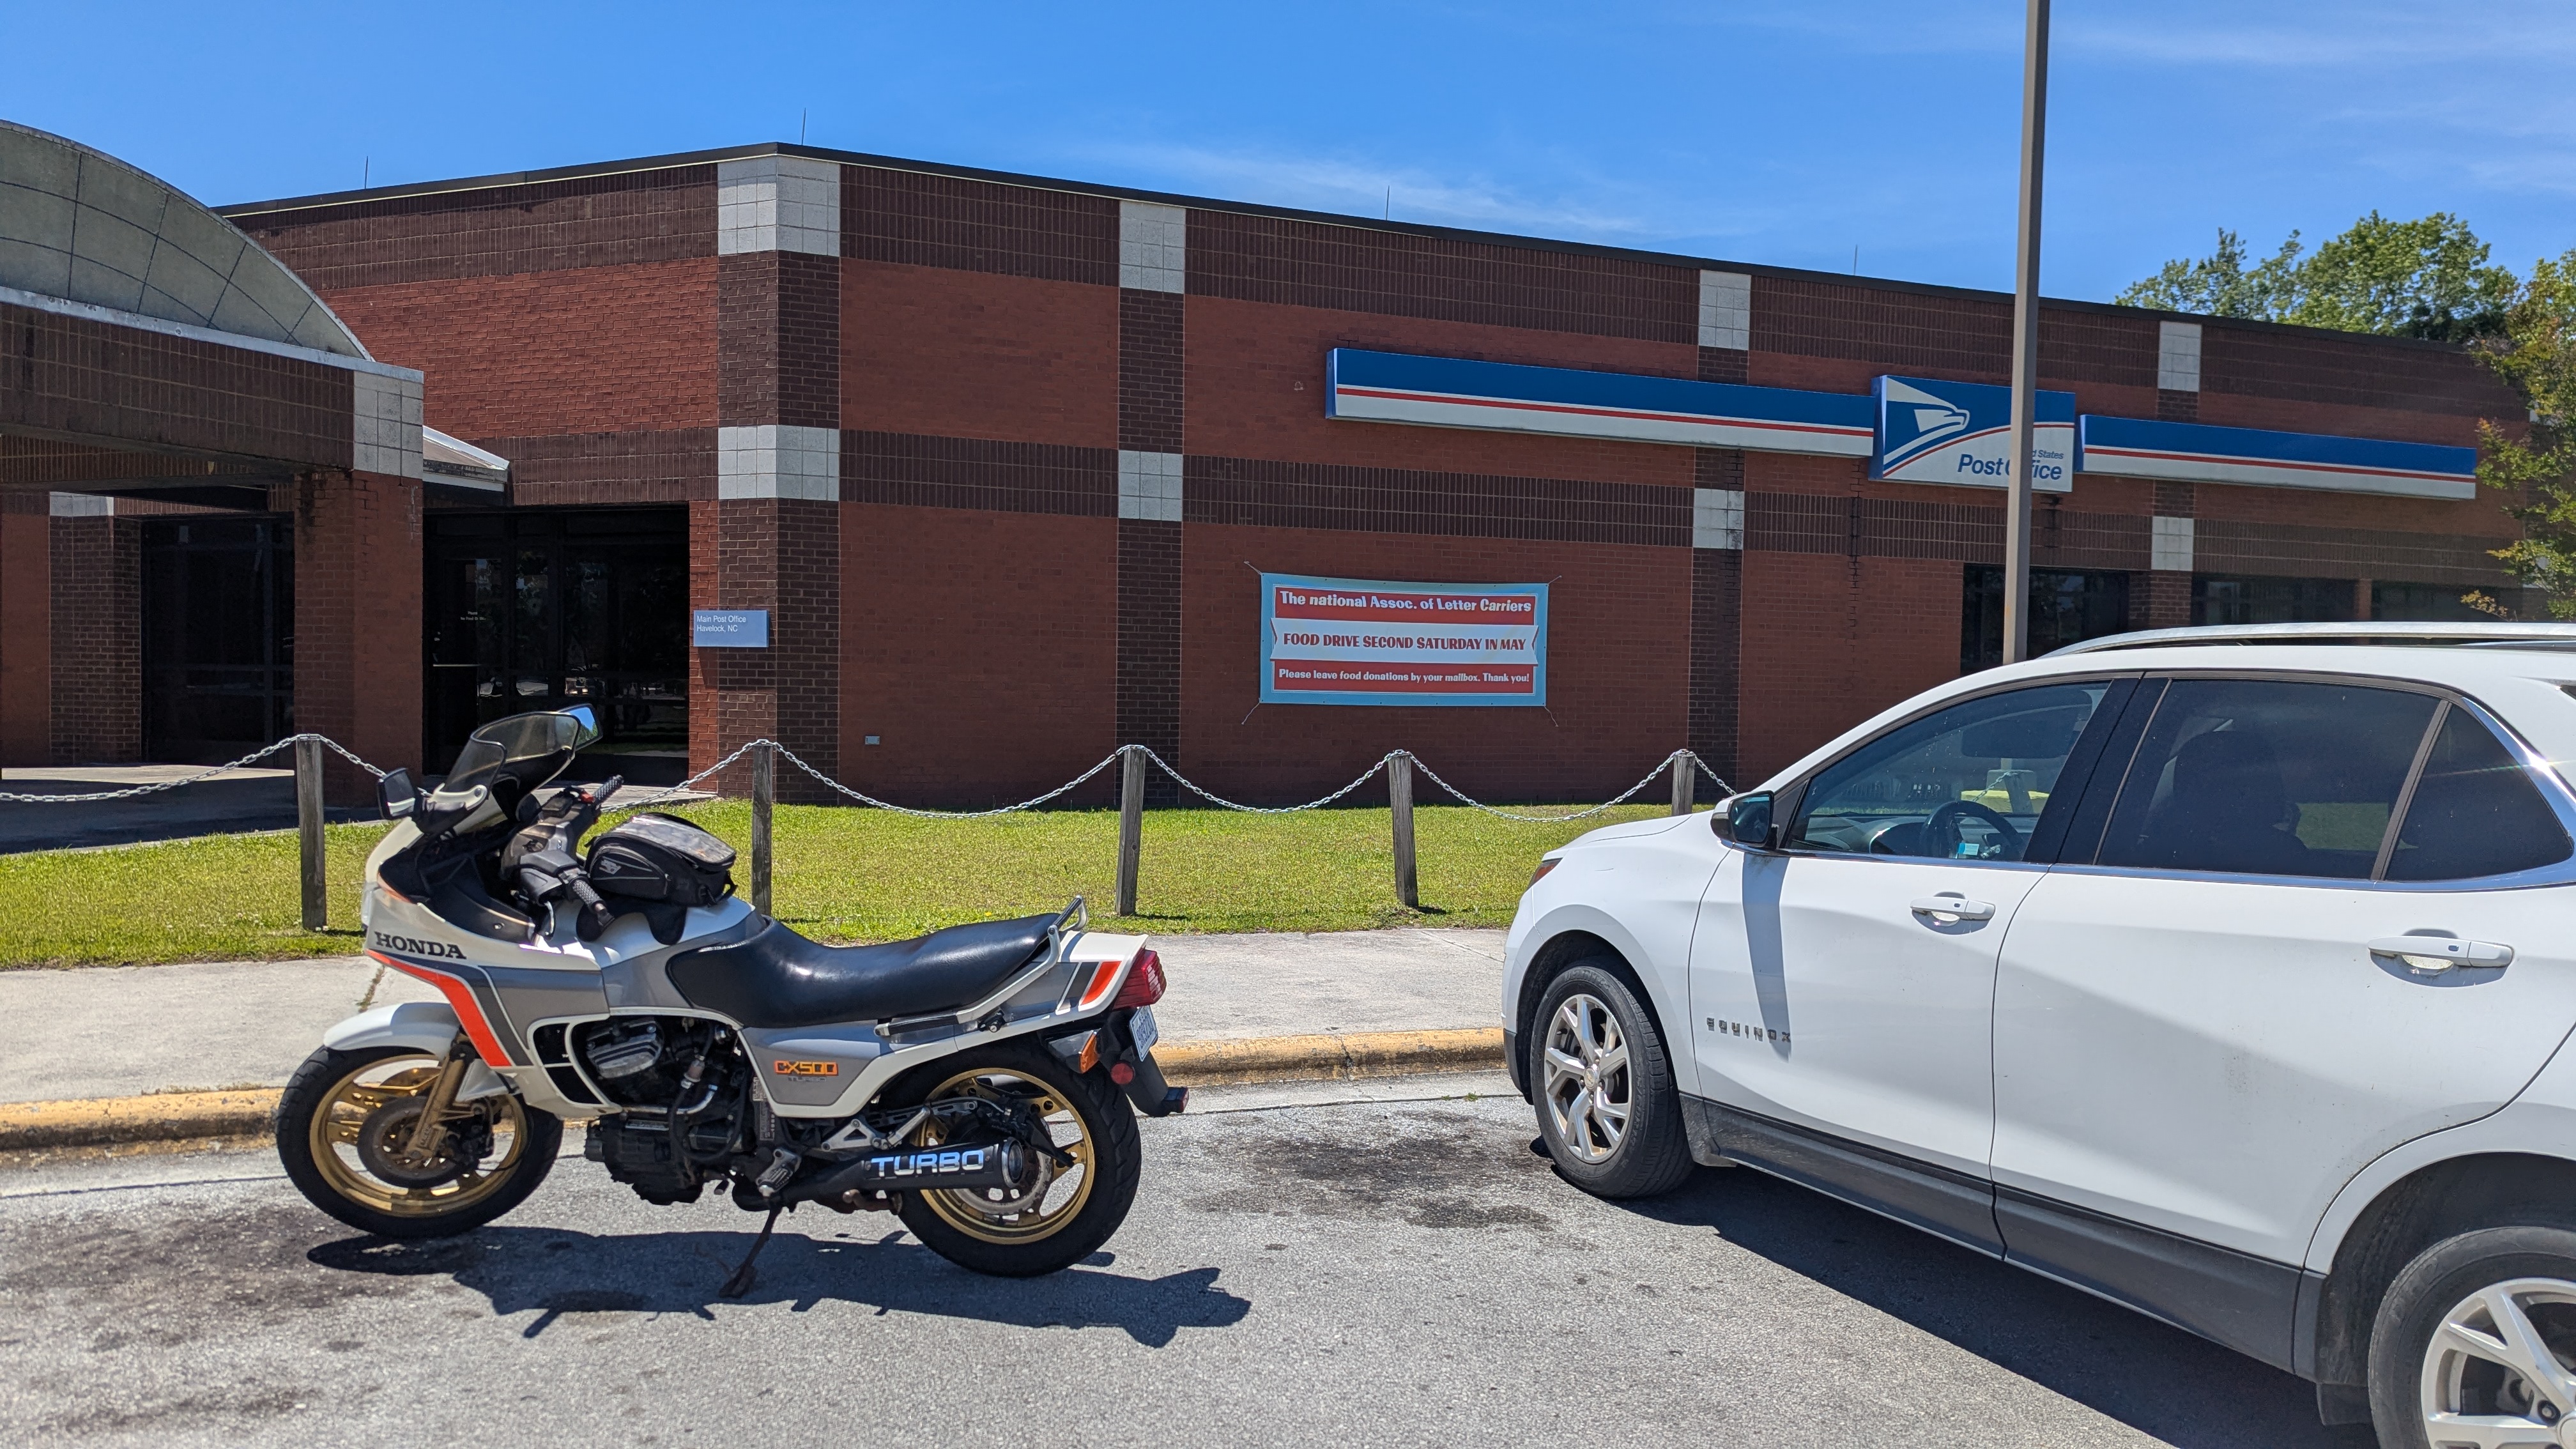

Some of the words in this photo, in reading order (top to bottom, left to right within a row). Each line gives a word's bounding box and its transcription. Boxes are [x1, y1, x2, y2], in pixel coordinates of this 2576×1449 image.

[1958, 454, 2004, 476] Post
[2038, 450, 2064, 459] States
[1280, 591, 1306, 605] The
[1310, 594, 1367, 608] national
[1370, 595, 1417, 609] Assoc.
[1420, 598, 1434, 610] of
[1437, 598, 1476, 611] Letter
[1480, 599, 1531, 612] Carriers
[1284, 633, 1320, 646] FOOD
[1323, 634, 1360, 647] DRIVE
[1363, 635, 1413, 648] SECOND
[1416, 637, 1482, 650] SATURDAY
[1485, 639, 1498, 650] IN
[1500, 639, 1526, 650] MAY
[1279, 668, 1311, 678] Please
[1314, 670, 1337, 679] leave
[1340, 671, 1361, 680] food
[1363, 671, 1409, 681] donations
[1411, 673, 1421, 683] by
[1423, 675, 1442, 684] your
[1445, 673, 1480, 682] mailbox.
[1482, 673, 1509, 682] Thank
[1511, 673, 1529, 684] you!
[374, 931, 467, 960] HONDA
[1706, 1017, 1791, 1042] EQUINOX
[774, 1060, 838, 1076] CX500
[871, 1150, 985, 1177] TURBO
